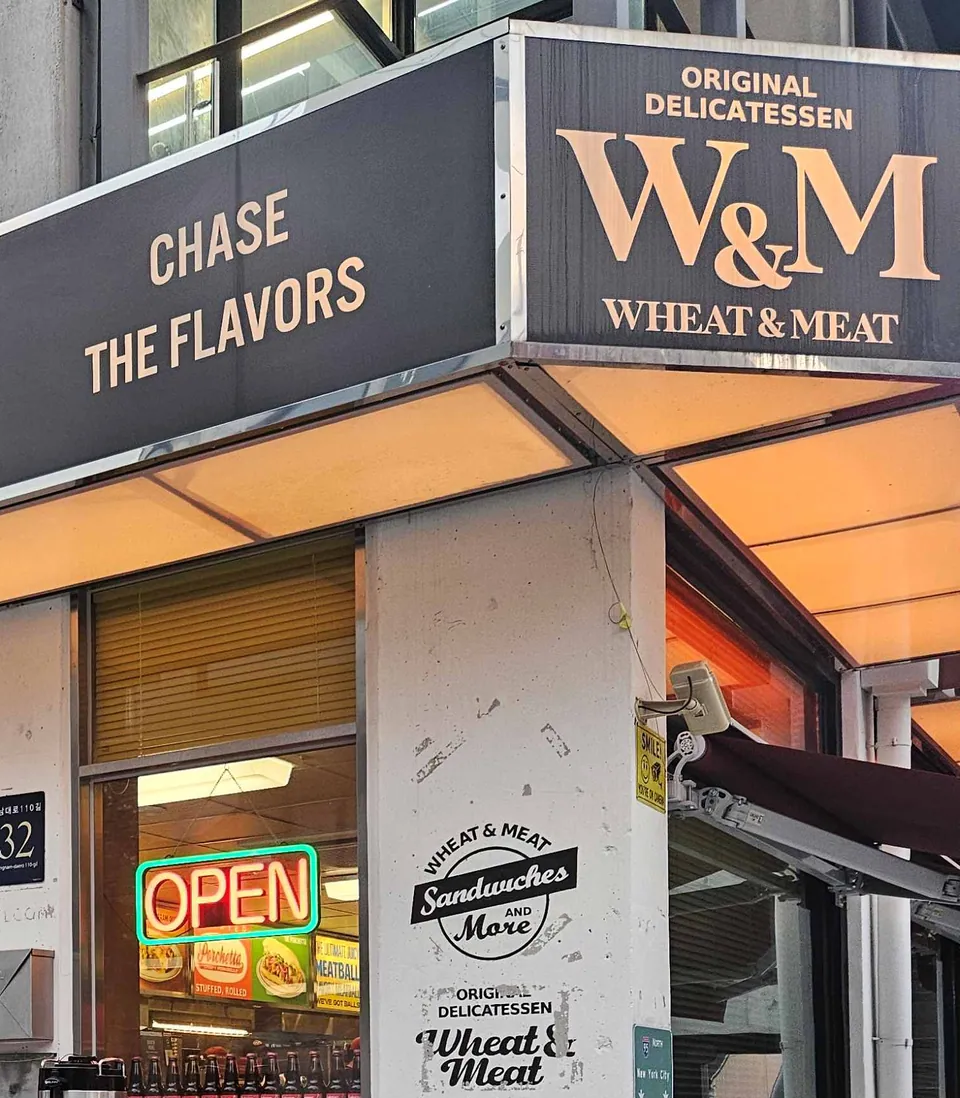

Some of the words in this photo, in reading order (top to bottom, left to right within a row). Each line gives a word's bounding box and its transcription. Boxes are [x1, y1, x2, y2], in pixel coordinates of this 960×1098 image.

[681, 66, 817, 98] ORIGINAL
[645, 93, 852, 130] DELICATESSEN
[555, 128, 940, 290] W&M
[149, 188, 289, 286] CHASE
[85, 324, 158, 394] THE
[170, 256, 366, 368] FLAVORS
[602, 298, 753, 337] WHEAT
[757, 307, 786, 339] &
[790, 309, 898, 344] MEAT
[642, 732, 661, 759] SMILE!
[424, 825, 480, 876] WHEAT
[483, 823, 496, 837] &
[500, 822, 552, 851] MEAT
[145, 858, 309, 932] OPEN
[420, 864, 569, 917] Sandwiches
[453, 913, 532, 942] More
[505, 906, 532, 917] AND
[195, 984, 223, 994] STUFFED,
[225, 985, 247, 997] ROLLED
[456, 988, 531, 1000] ORIGI
[438, 1002, 552, 1018] DELICATESSEN
[440, 1055, 545, 1087] Meat
[637, 1068, 646, 1078] New
[648, 1069, 658, 1079] York
[660, 1070, 670, 1082] City
